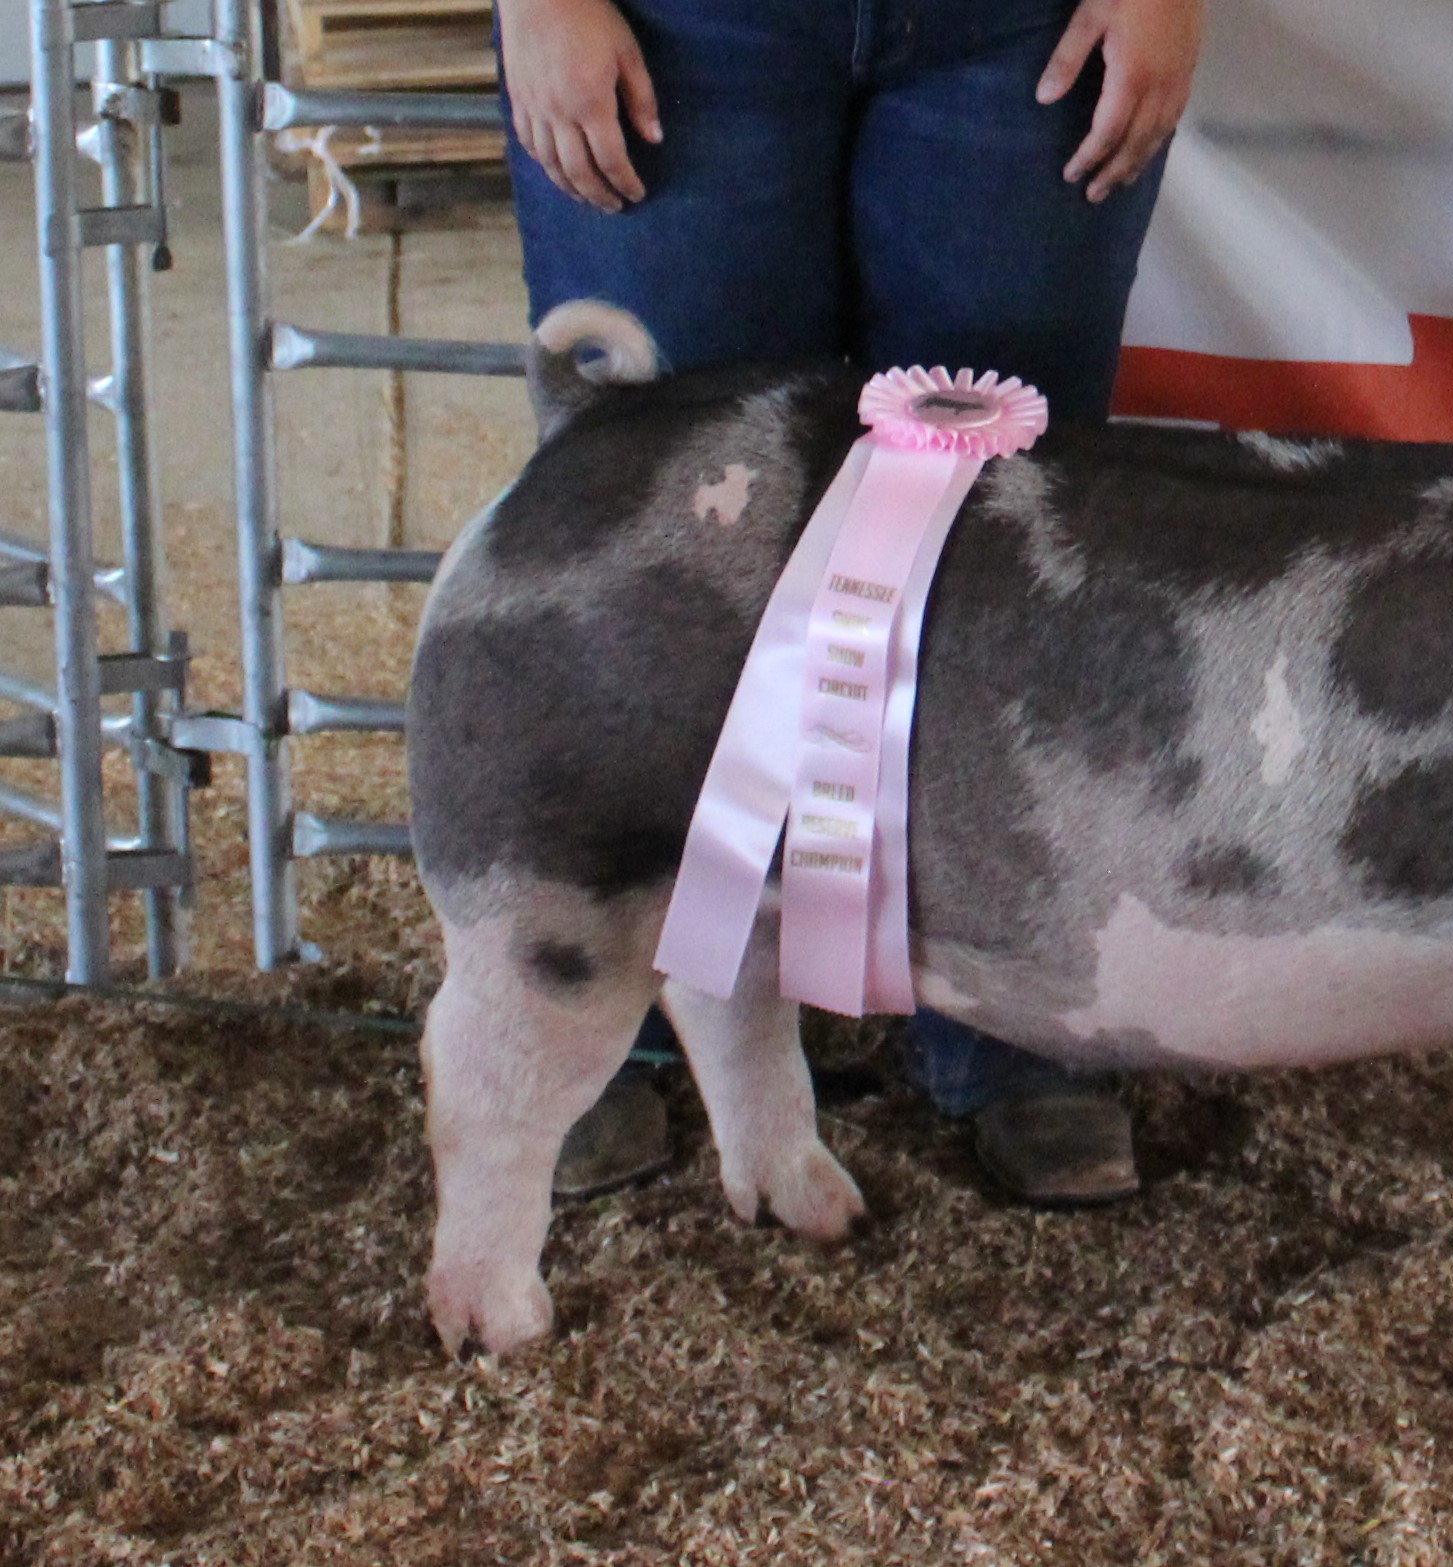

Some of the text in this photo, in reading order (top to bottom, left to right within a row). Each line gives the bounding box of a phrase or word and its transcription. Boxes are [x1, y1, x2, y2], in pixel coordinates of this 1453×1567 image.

[829, 574, 898, 604] TENNESSEE
[828, 644, 866, 668] SHOW
[818, 678, 868, 701] CIRCUIT
[813, 781, 856, 802] BREED
[791, 851, 863, 875] CHAMPION
